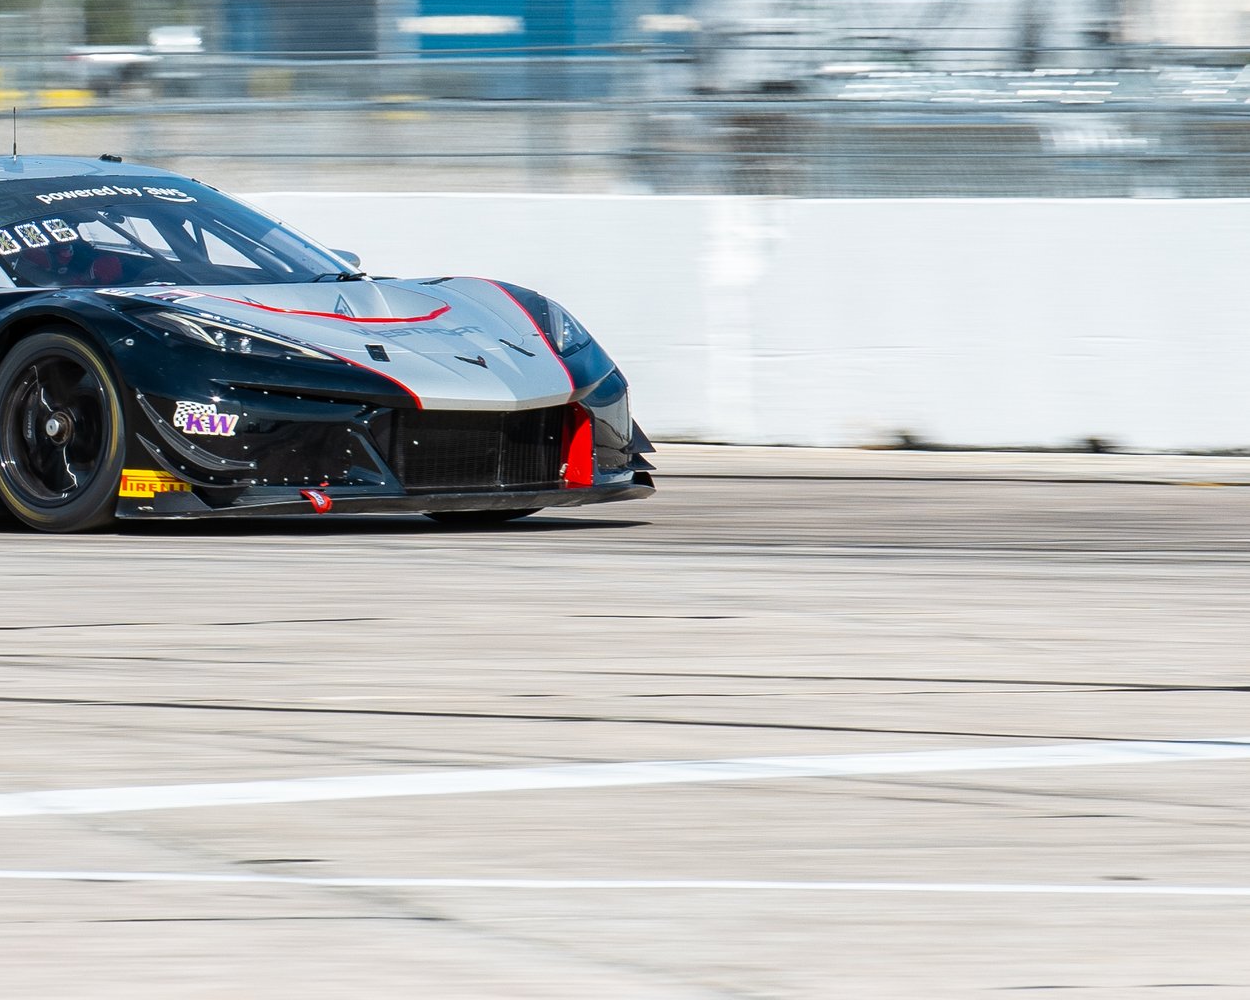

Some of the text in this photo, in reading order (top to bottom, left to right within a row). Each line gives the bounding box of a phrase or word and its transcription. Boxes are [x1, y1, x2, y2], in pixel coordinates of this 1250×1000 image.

[36, 185, 188, 205] powered by aws
[186, 412, 236, 434] KW
[121, 475, 185, 492] PIRELLI
